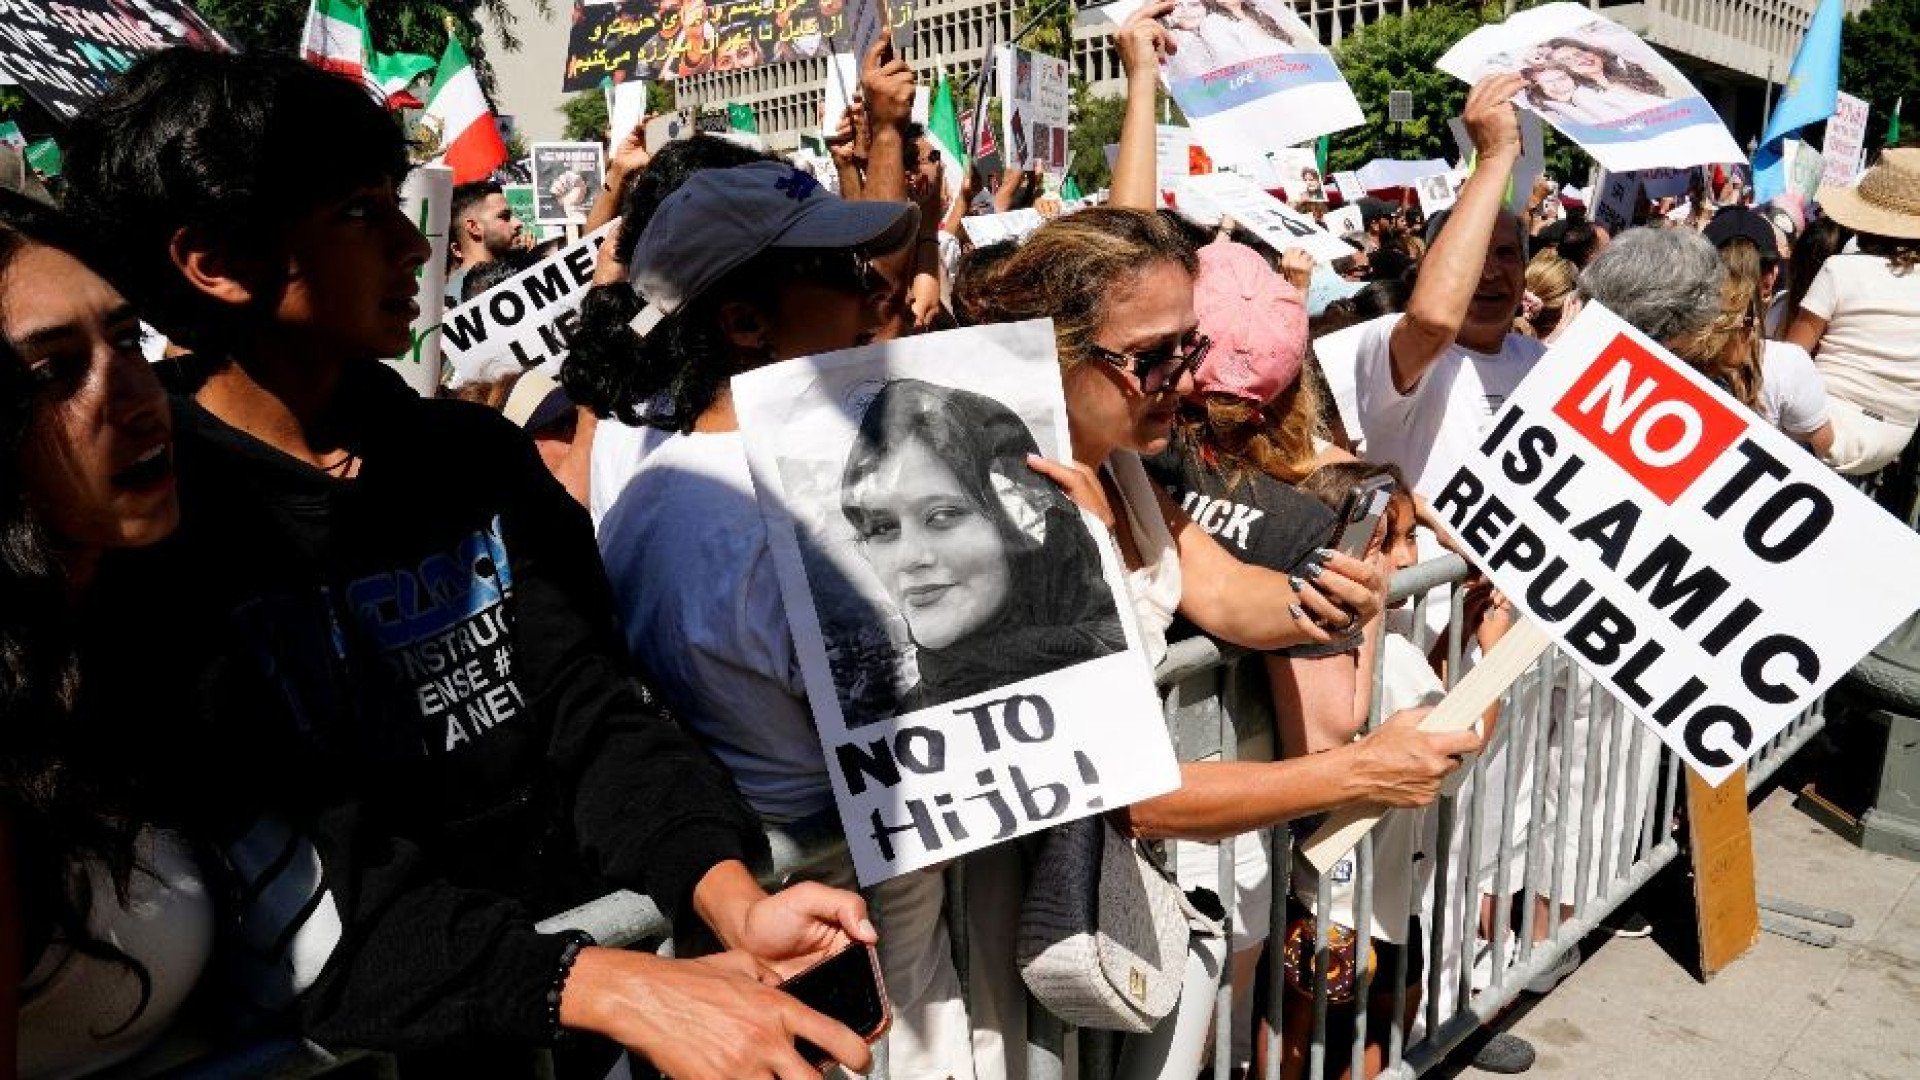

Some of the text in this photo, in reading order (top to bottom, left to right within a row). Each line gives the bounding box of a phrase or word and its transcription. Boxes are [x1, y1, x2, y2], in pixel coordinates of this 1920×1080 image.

[442, 236, 606, 352] WOME
[1480, 404, 1820, 705] ISLAMIC
[1578, 358, 1835, 564] NO TO
[1433, 465, 1753, 768] REPUBLIC
[835, 694, 1055, 797] NO TO
